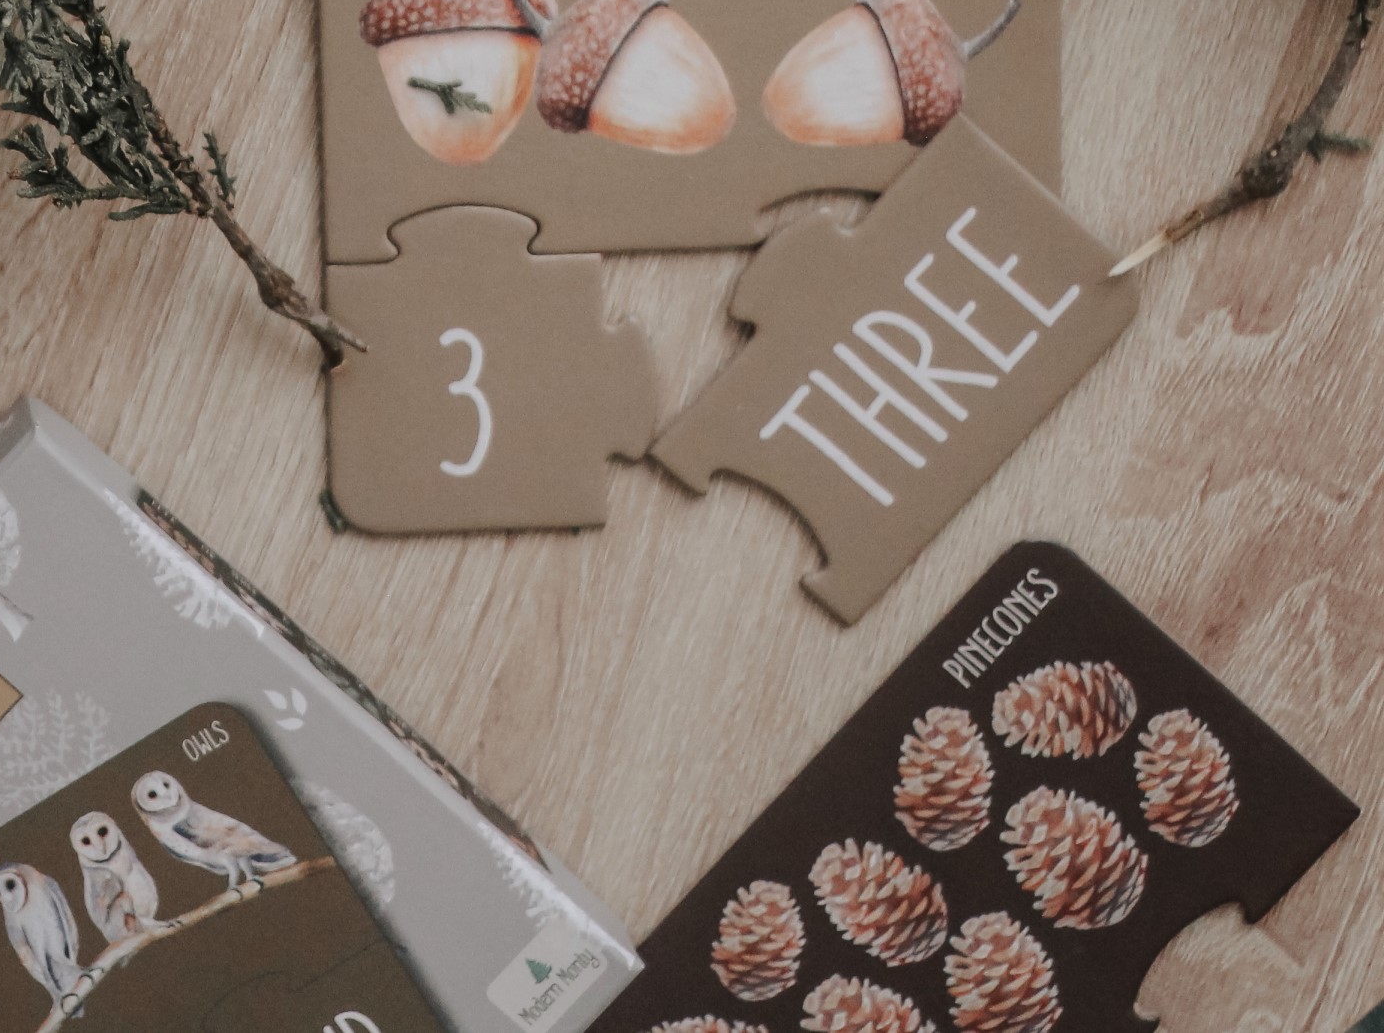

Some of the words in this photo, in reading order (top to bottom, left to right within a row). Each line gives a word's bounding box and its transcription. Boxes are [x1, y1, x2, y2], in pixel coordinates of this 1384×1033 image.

[439, 327, 492, 477] 3
[759, 207, 1081, 507] THREE
[942, 568, 1058, 689] PINECONES
[182, 720, 230, 761] OWLS
[517, 982, 564, 1026] Modern
[556, 948, 600, 986] Monty
